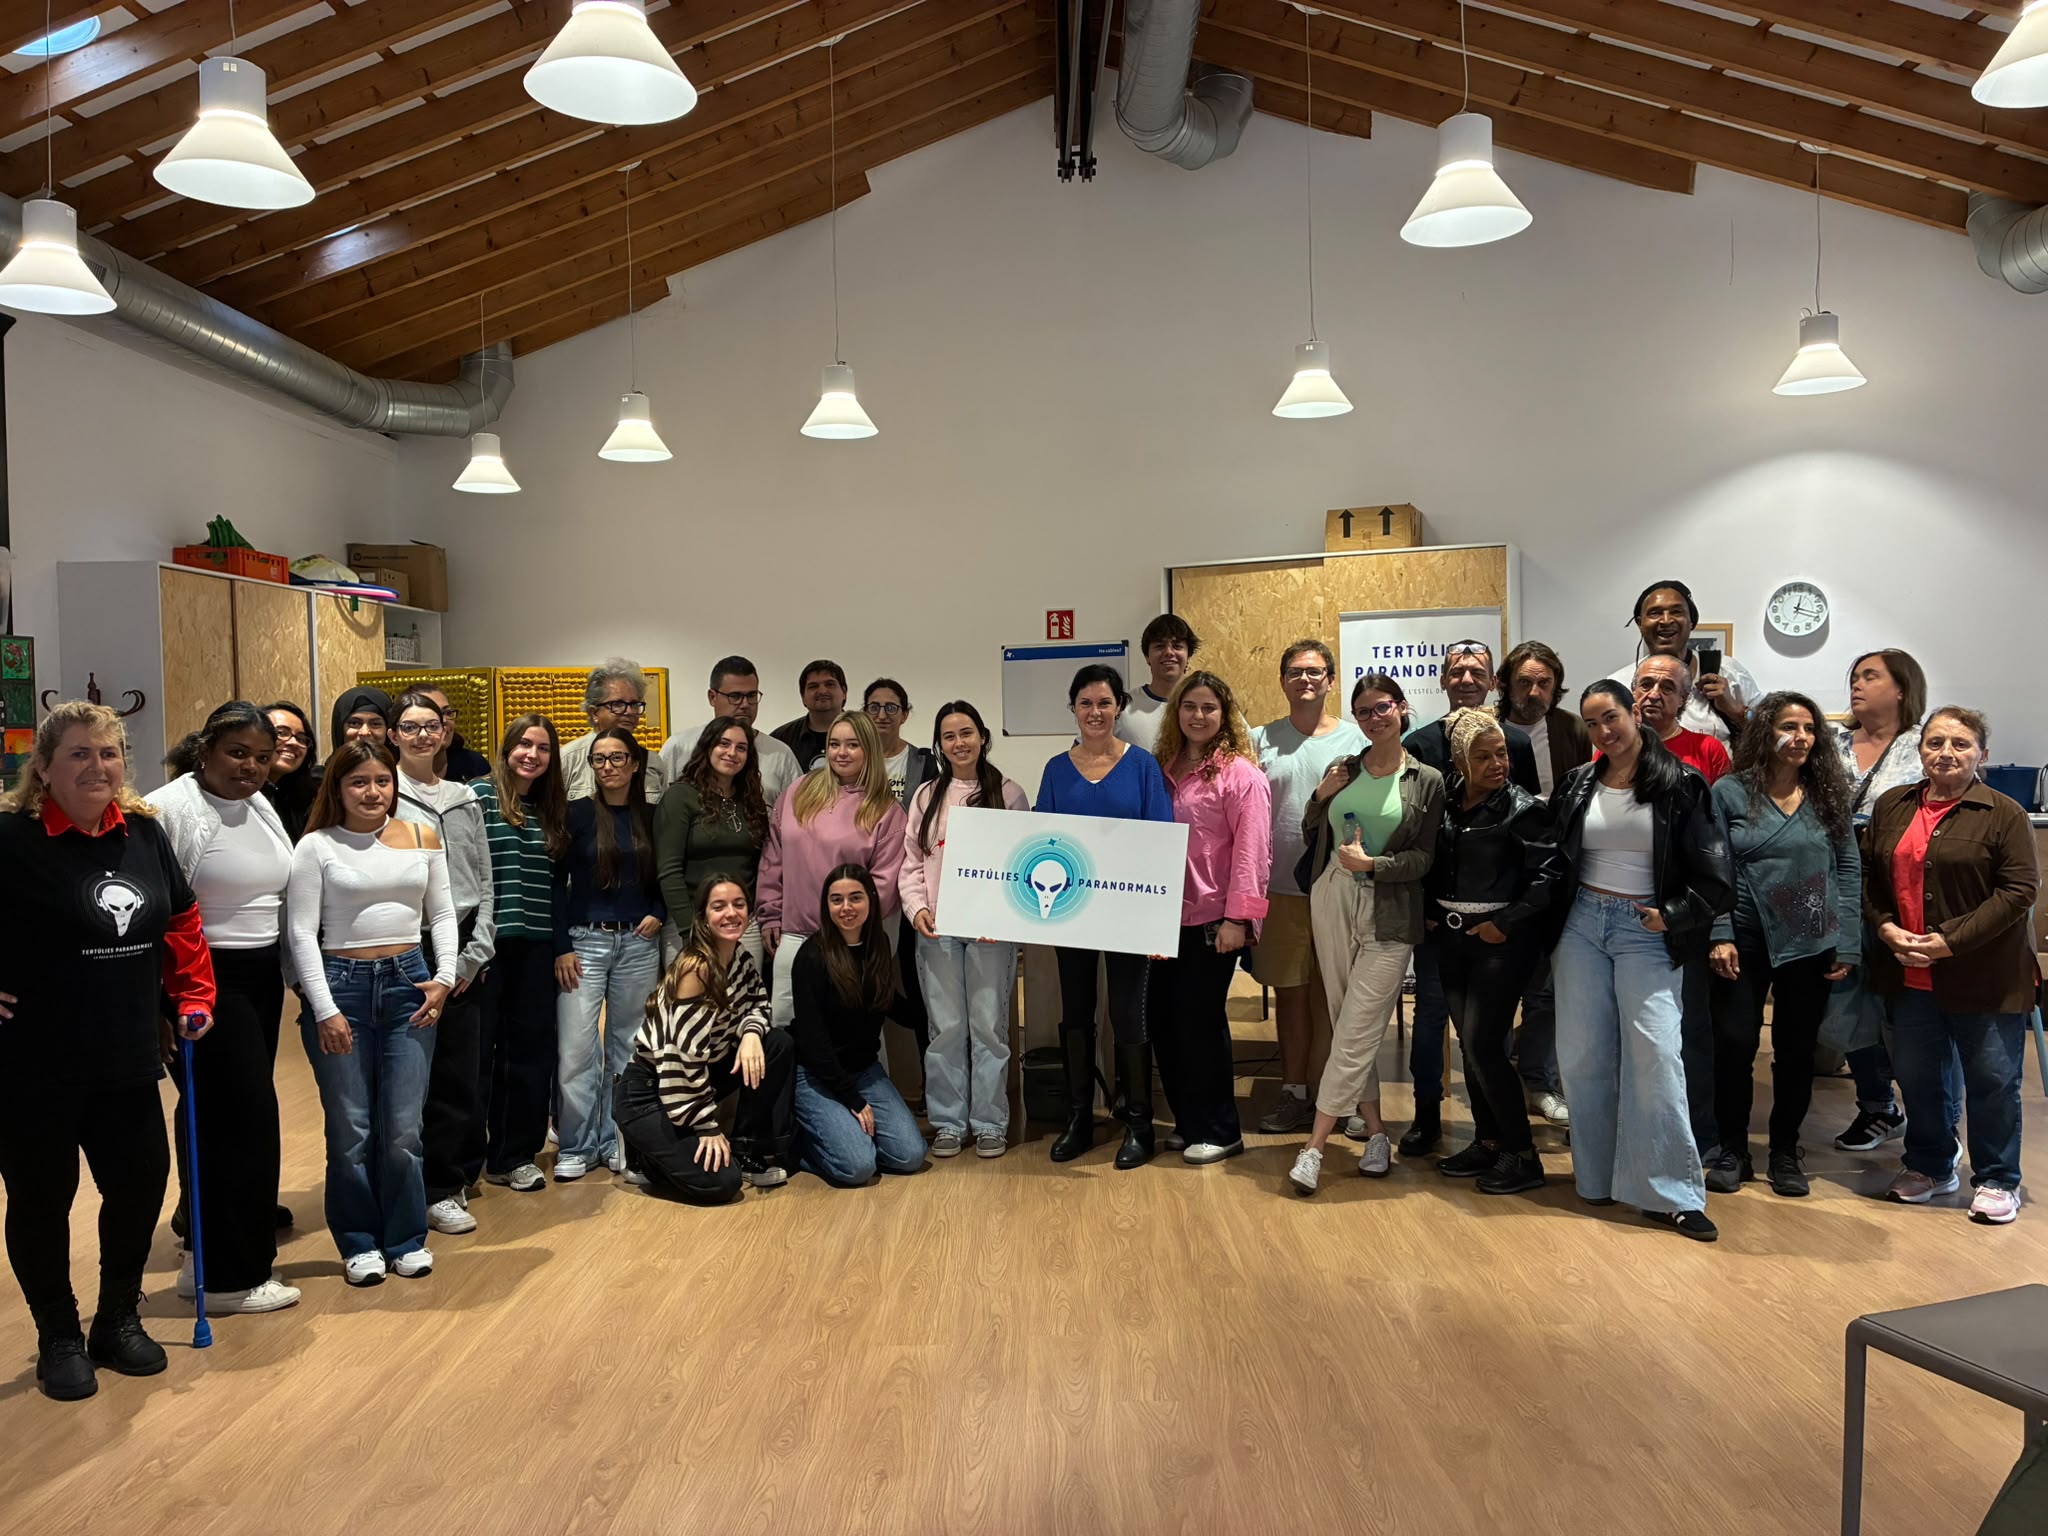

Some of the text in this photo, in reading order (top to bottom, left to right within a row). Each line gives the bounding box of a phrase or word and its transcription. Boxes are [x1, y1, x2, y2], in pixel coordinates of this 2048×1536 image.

[1772, 605, 1779, 613] 9
[1816, 604, 1824, 613] 3
[1774, 615, 1781, 623] 8
[1782, 623, 1789, 631] 7
[1793, 625, 1800, 633] 6
[1805, 623, 1812, 631] 5
[1372, 641, 1445, 658] TERTÚLI
[1355, 664, 1444, 679] PARANOR
[957, 867, 1167, 896] TERTÚLIES PARANORMALS
[82, 947, 114, 955] TERTÚLIES
[115, 942, 153, 952] PARANORMALS
